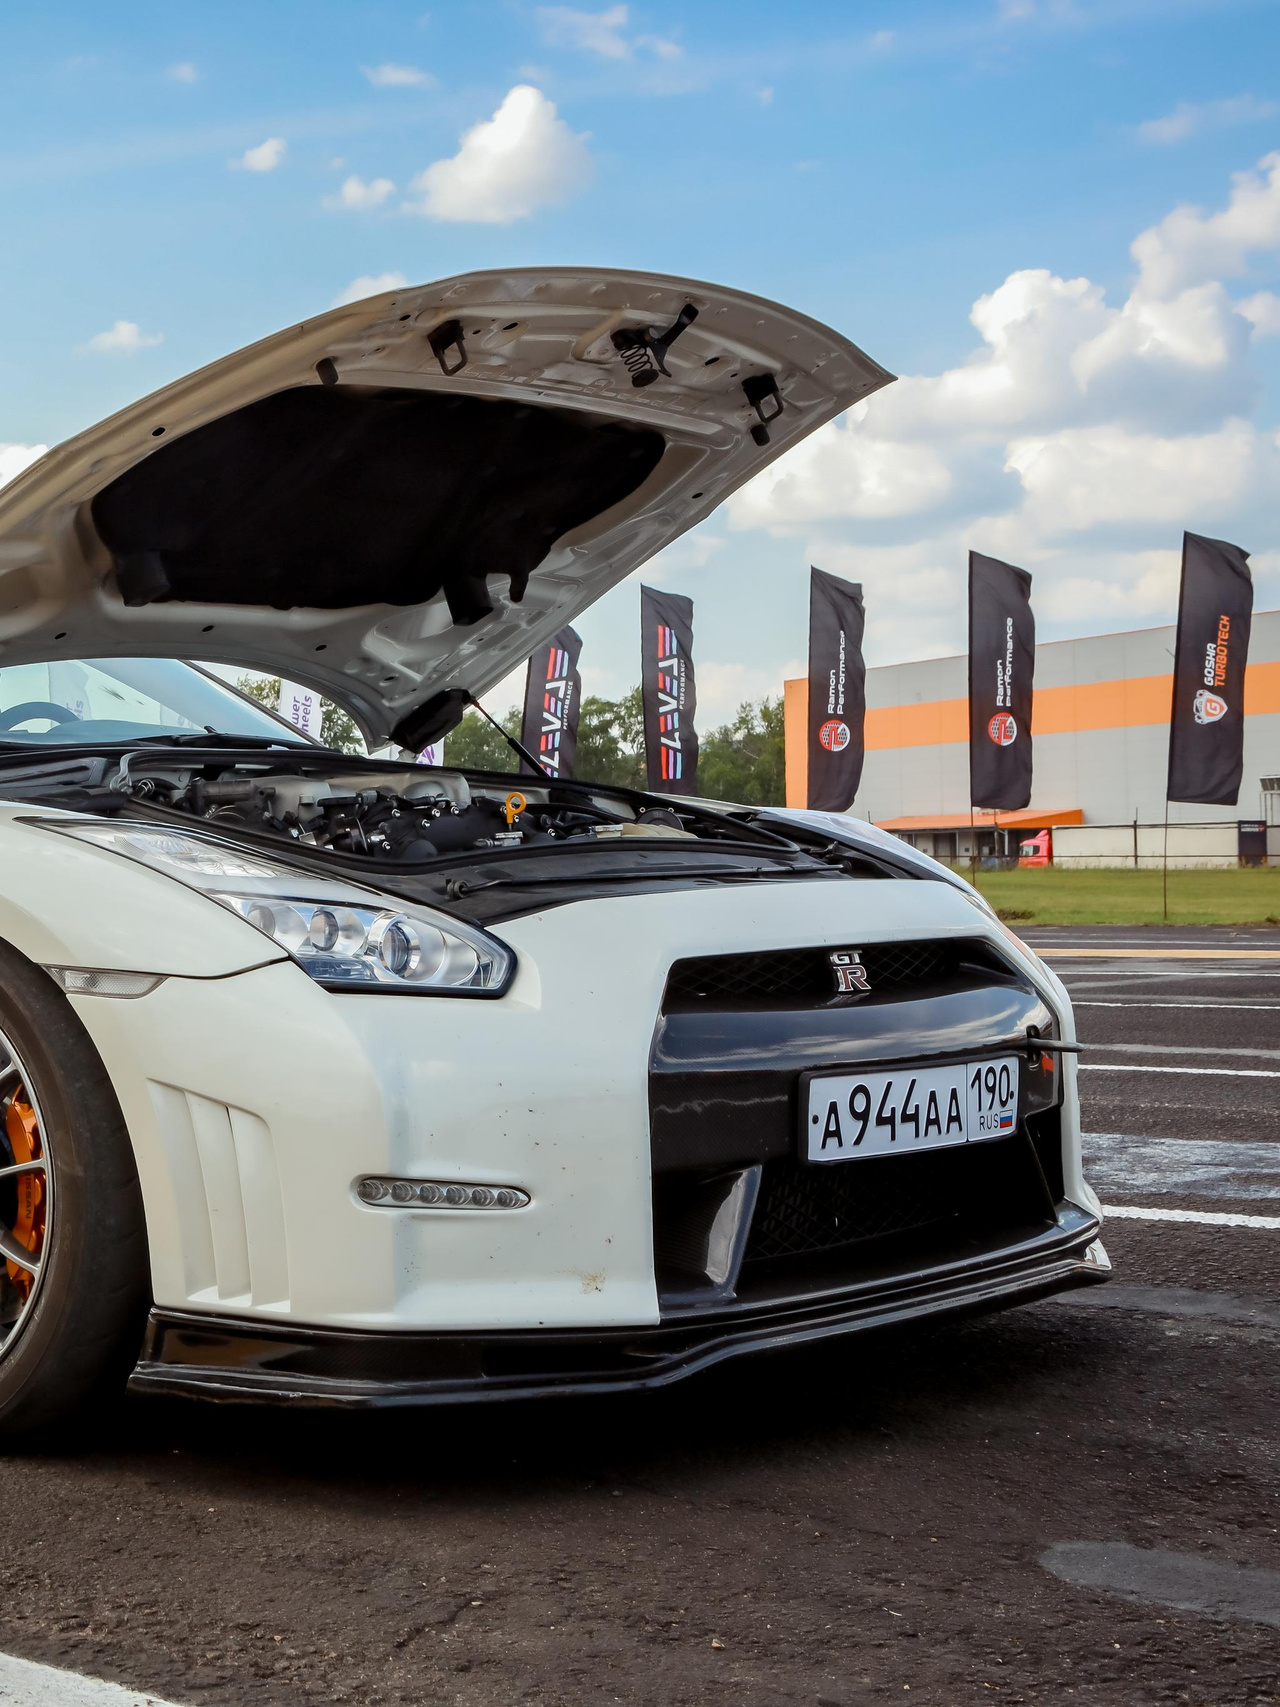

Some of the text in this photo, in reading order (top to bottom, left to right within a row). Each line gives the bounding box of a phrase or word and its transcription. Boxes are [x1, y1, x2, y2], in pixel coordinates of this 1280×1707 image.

[837, 630, 846, 714] Performance
[1005, 617, 1013, 706] Performance
[1204, 643, 1216, 686] GOSHA
[1214, 615, 1230, 686] TURBOTECH
[562, 681, 573, 730] PERFORMANCE
[827, 669, 836, 714] Ramon
[970, 1064, 1011, 1112] 190
[980, 1113, 1000, 1131] RUS
